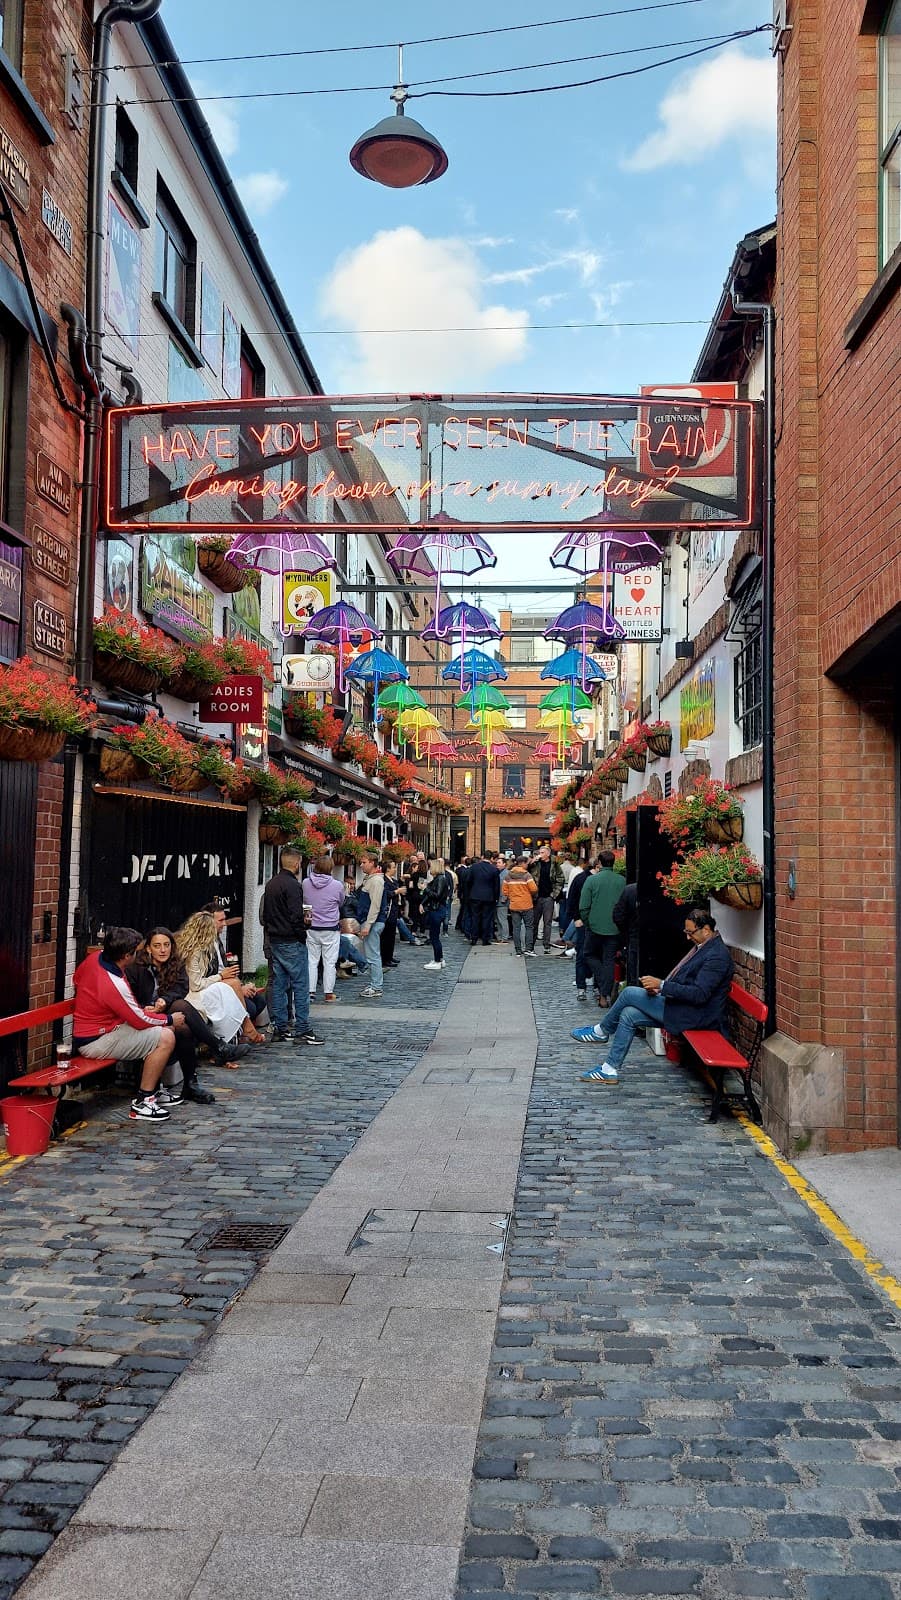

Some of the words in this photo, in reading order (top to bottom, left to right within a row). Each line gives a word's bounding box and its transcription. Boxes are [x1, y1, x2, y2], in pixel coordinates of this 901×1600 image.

[0, 128, 30, 187] RASNA
[654, 414, 700, 424] GUINNESS
[143, 429, 234, 464] HAVE
[250, 420, 319, 456] YOU
[336, 416, 422, 449] EVER
[444, 416, 528, 449] SEEN
[547, 418, 614, 450] THE
[632, 422, 717, 458] RAIN
[49, 463, 63, 487] AVA
[185, 463, 305, 509] Coming
[310, 470, 399, 499] down
[406, 480, 446, 499] on
[453, 480, 483, 497] a
[487, 480, 589, 509] sunny
[593, 465, 680, 508] day?
[40, 476, 71, 510] AVENUE
[37, 532, 68, 563] ARBOUR
[36, 549, 68, 579] STREET
[624, 575, 652, 584] RED
[37, 606, 65, 634] KELLS
[615, 606, 661, 616] HEART
[35, 625, 66, 651] STREET
[616, 629, 660, 638] GINNESS
[211, 687, 253, 696] ADIES
[210, 702, 250, 712] ROOM
